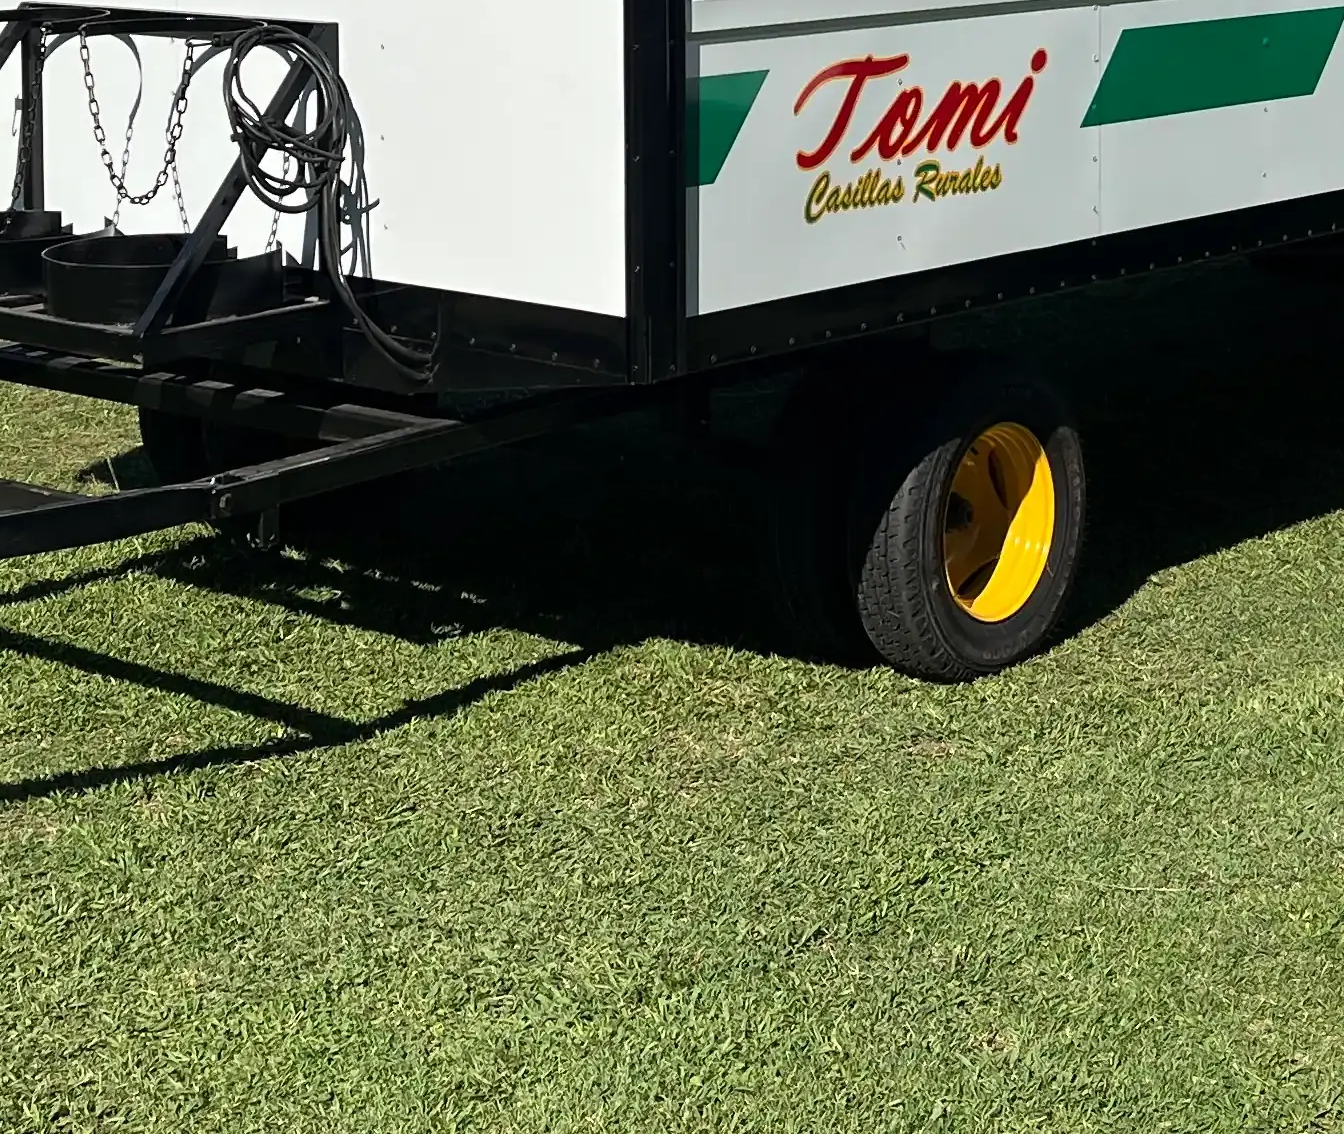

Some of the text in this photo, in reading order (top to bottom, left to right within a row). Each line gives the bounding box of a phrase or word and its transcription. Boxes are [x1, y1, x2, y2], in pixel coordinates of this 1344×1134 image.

[793, 47, 1048, 171] Tomi
[804, 154, 1003, 224] Casillas Rurales
